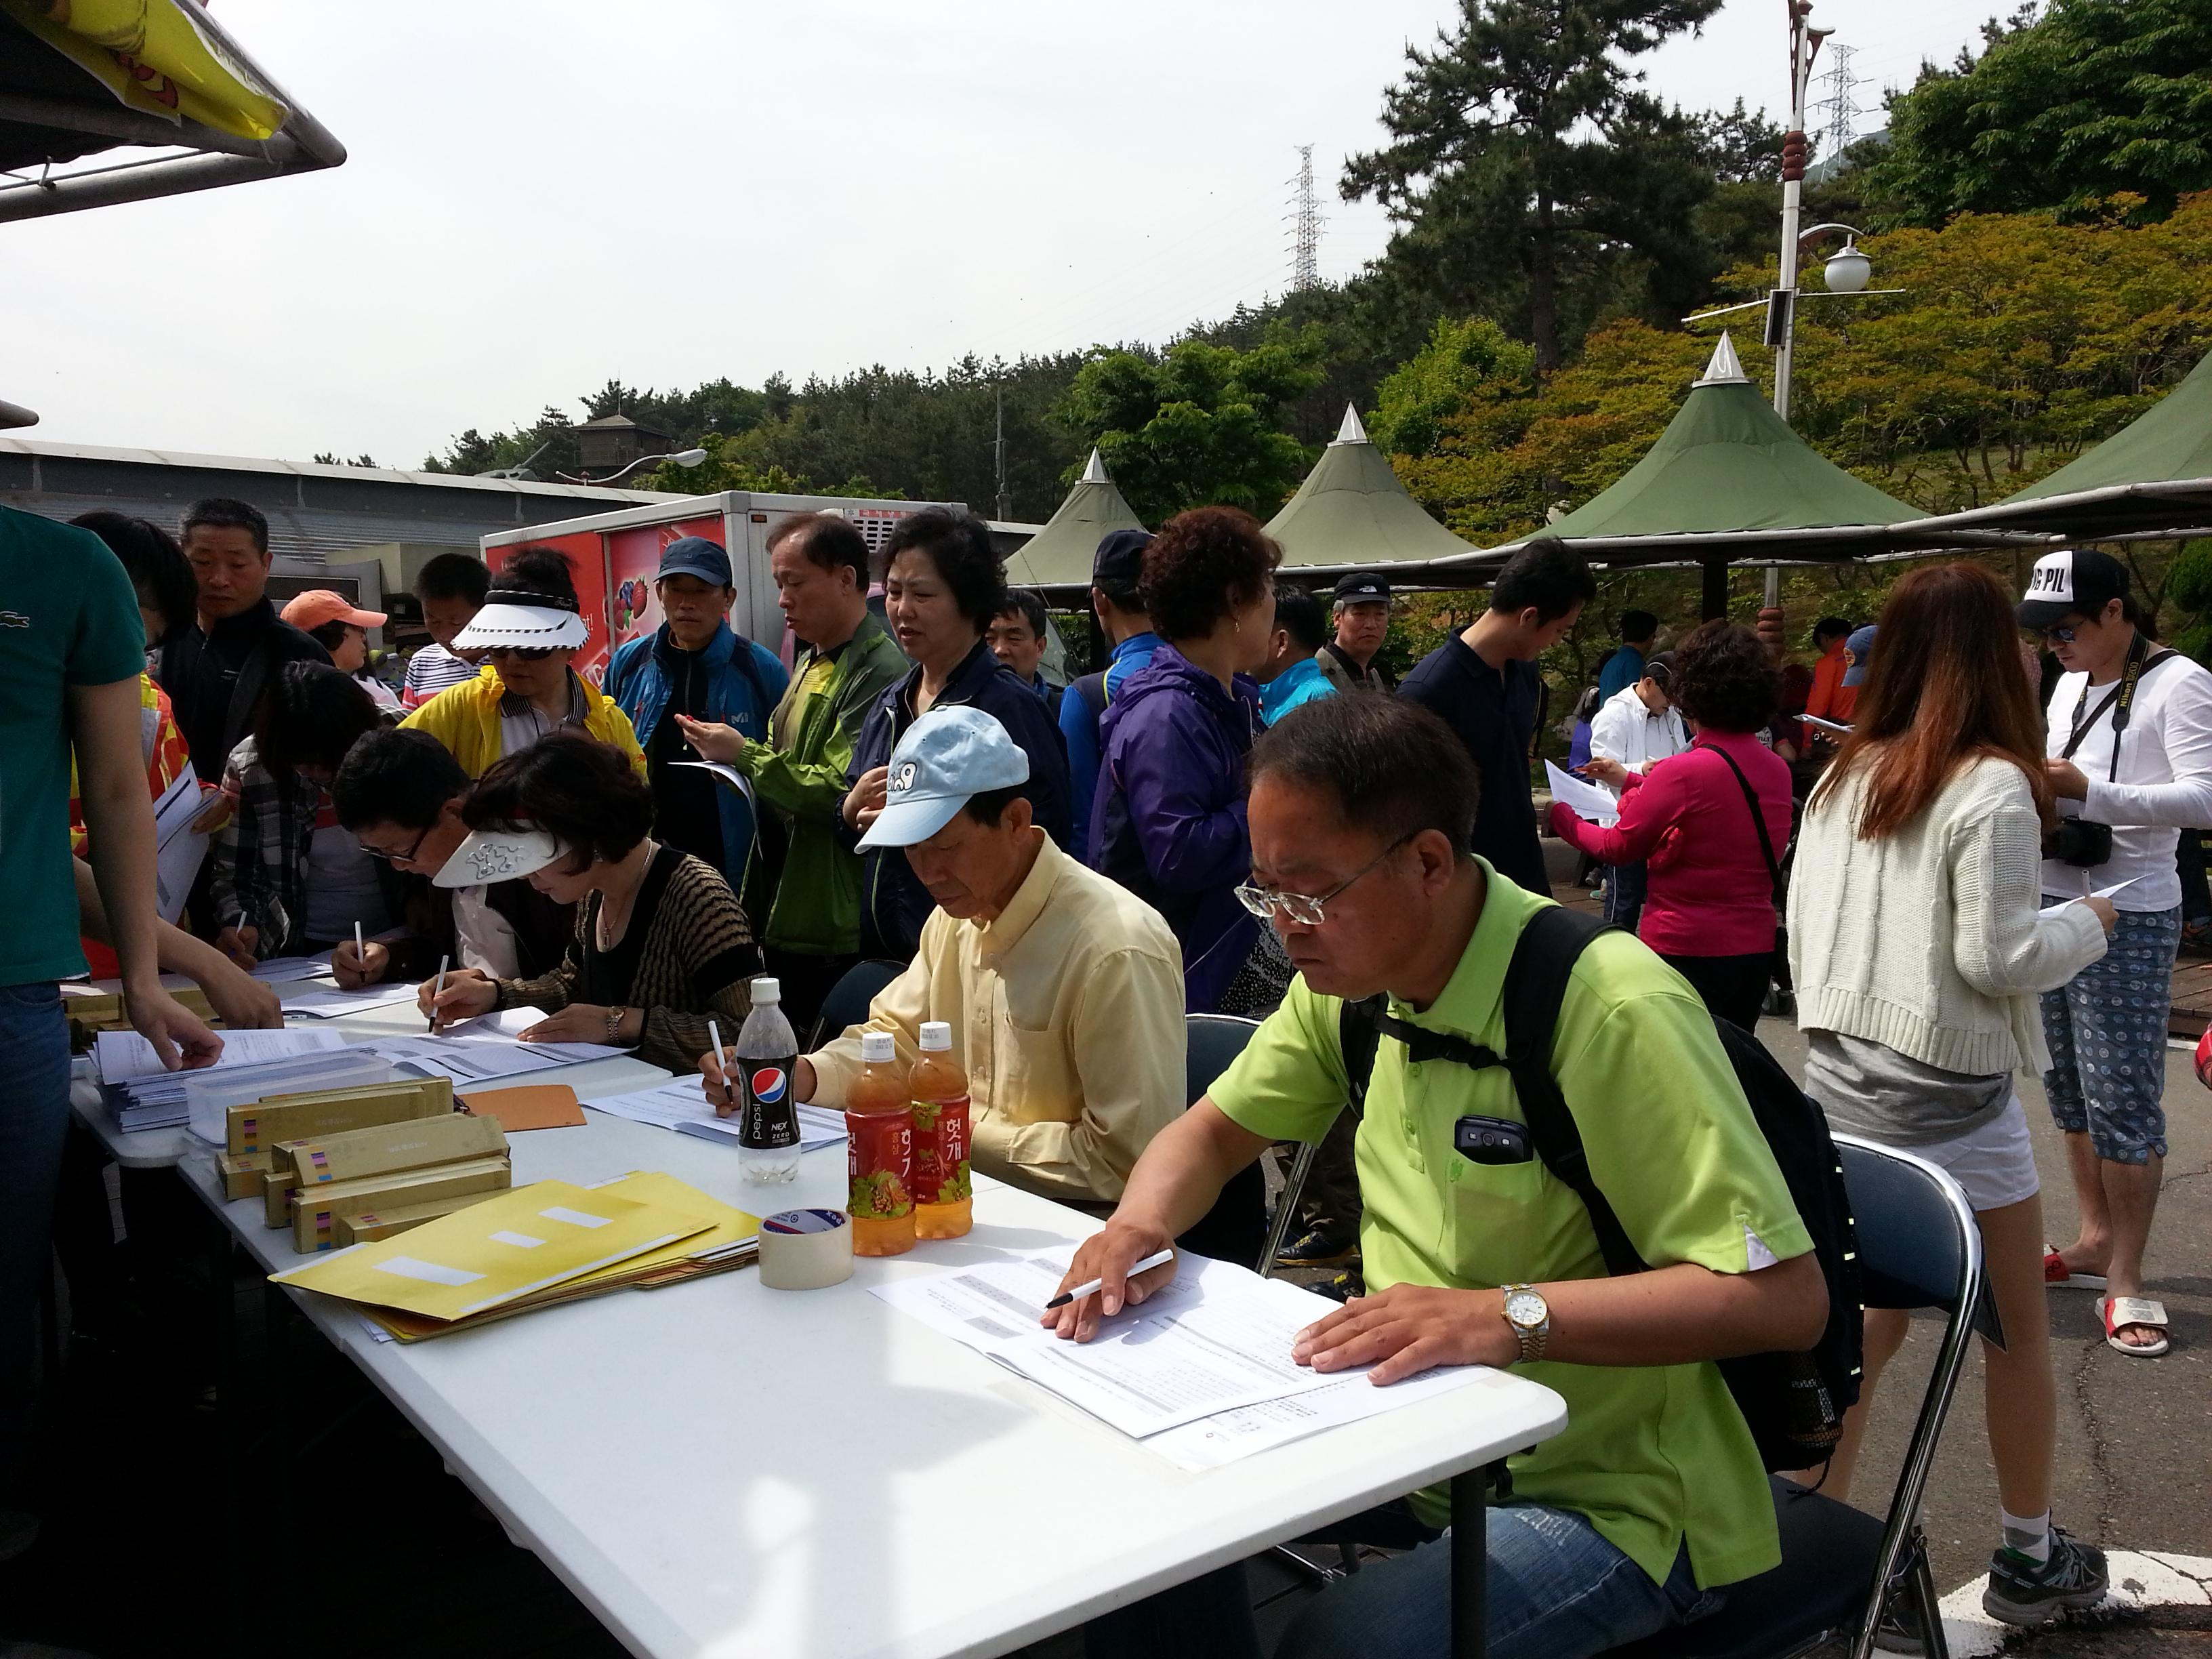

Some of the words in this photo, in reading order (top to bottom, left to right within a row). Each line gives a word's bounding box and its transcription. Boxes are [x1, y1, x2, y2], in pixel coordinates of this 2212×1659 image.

[2119, 682, 2133, 707] Nikon
[752, 1103, 763, 1140] pepsi
[771, 1120, 788, 1132] NEX
[772, 1131, 790, 1139] ZERO
